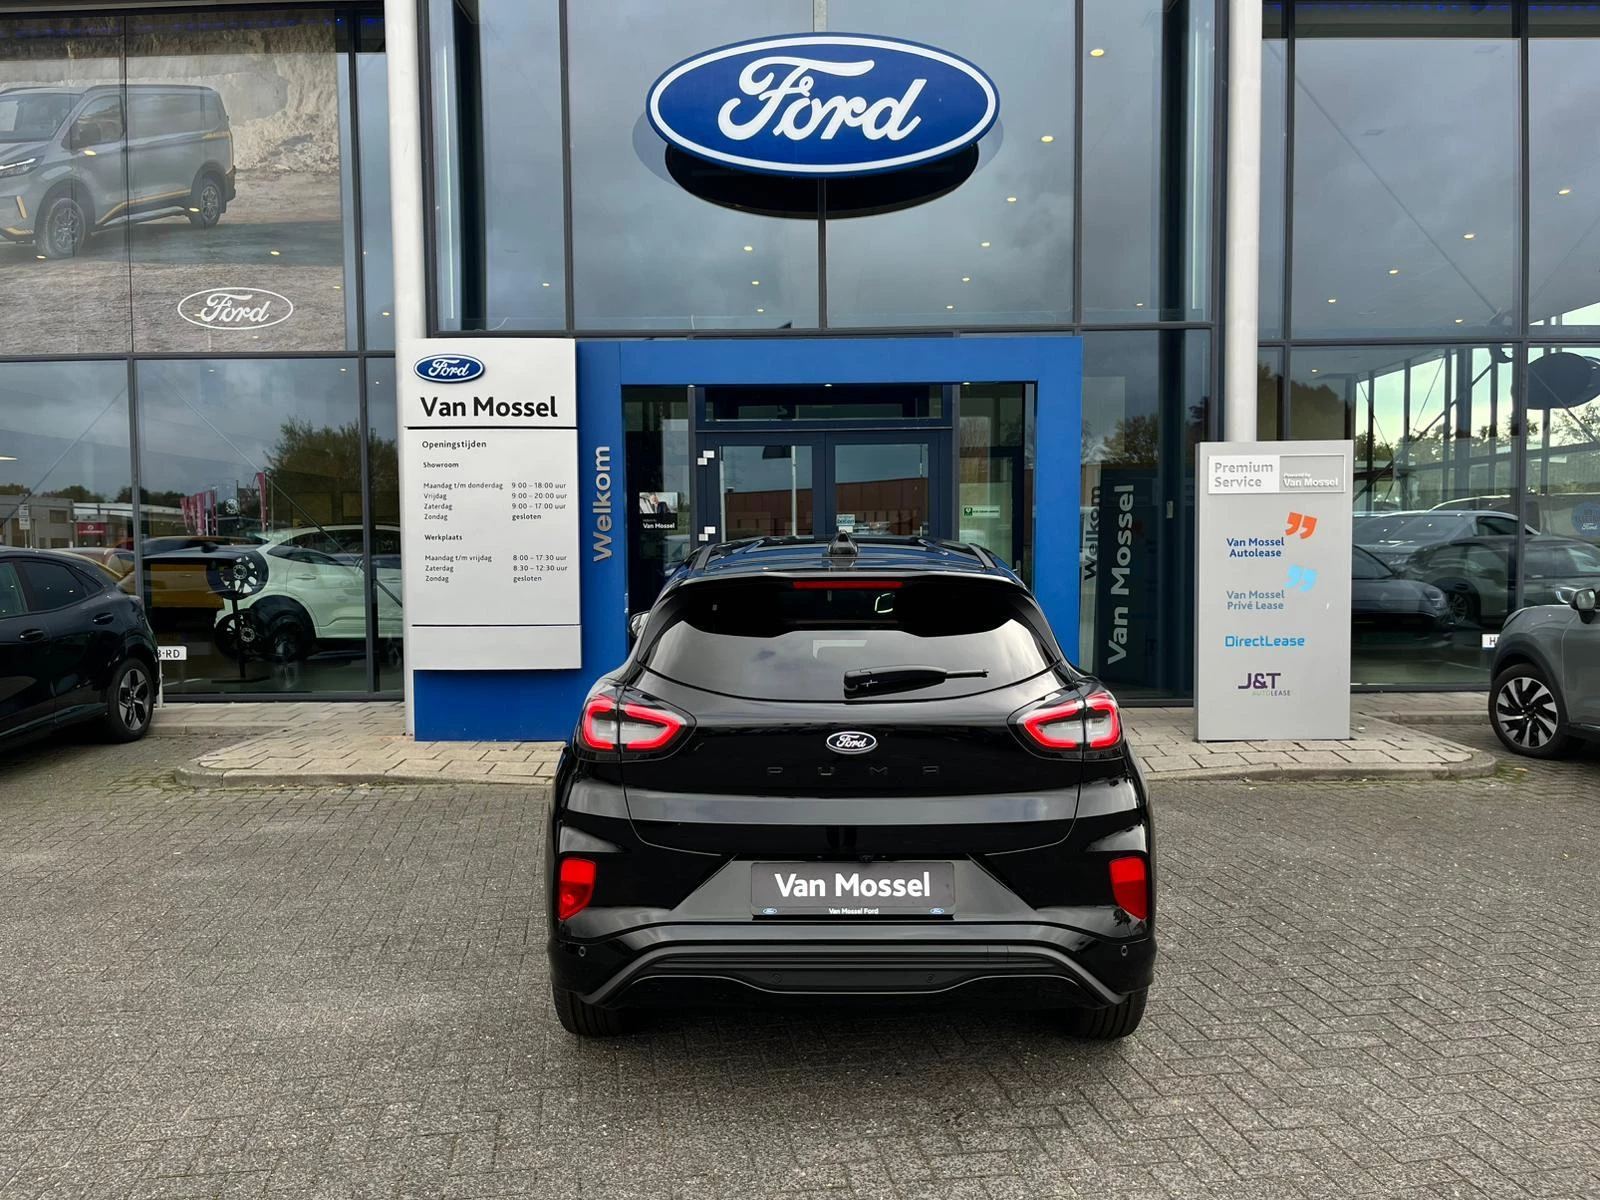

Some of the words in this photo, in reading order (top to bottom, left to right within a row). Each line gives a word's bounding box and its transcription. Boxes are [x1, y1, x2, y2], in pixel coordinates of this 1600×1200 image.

[717, 55, 928, 141] Ford
[200, 293, 271, 322] Ford
[428, 358, 470, 376] Ford
[420, 396, 466, 418] Van
[473, 396, 558, 418] Mossel
[422, 440, 487, 450] Openingstijden
[1214, 461, 1274, 473] Premium
[423, 482, 452, 491] Maandag
[468, 482, 504, 490] donderdag
[1214, 476, 1262, 488] Service
[1284, 478, 1302, 487] Van
[1304, 477, 1338, 487] Mossel
[424, 503, 452, 511] Zaterdag
[592, 446, 612, 562] Welkom
[424, 514, 448, 522] Zondag
[512, 513, 542, 522] gesloten
[1110, 484, 1134, 596] Mossel
[1226, 538, 1246, 546] Van
[1248, 537, 1285, 546] Mossel
[424, 554, 454, 562] Maandag
[469, 554, 492, 562] vrijdag
[1229, 548, 1282, 557] Autolease
[426, 575, 449, 583] Zondag
[513, 575, 542, 583] gesloten
[1226, 590, 1246, 599] Van
[1248, 590, 1285, 599] Mossel
[1227, 601, 1254, 610] Privé
[1256, 601, 1284, 610] Lease
[1107, 606, 1129, 664] Van
[1225, 636, 1305, 647] DirectLease
[1238, 672, 1282, 689] J&T
[836, 734, 867, 748] Ford
[774, 873, 826, 897] Van
[835, 872, 930, 897] Mossel
